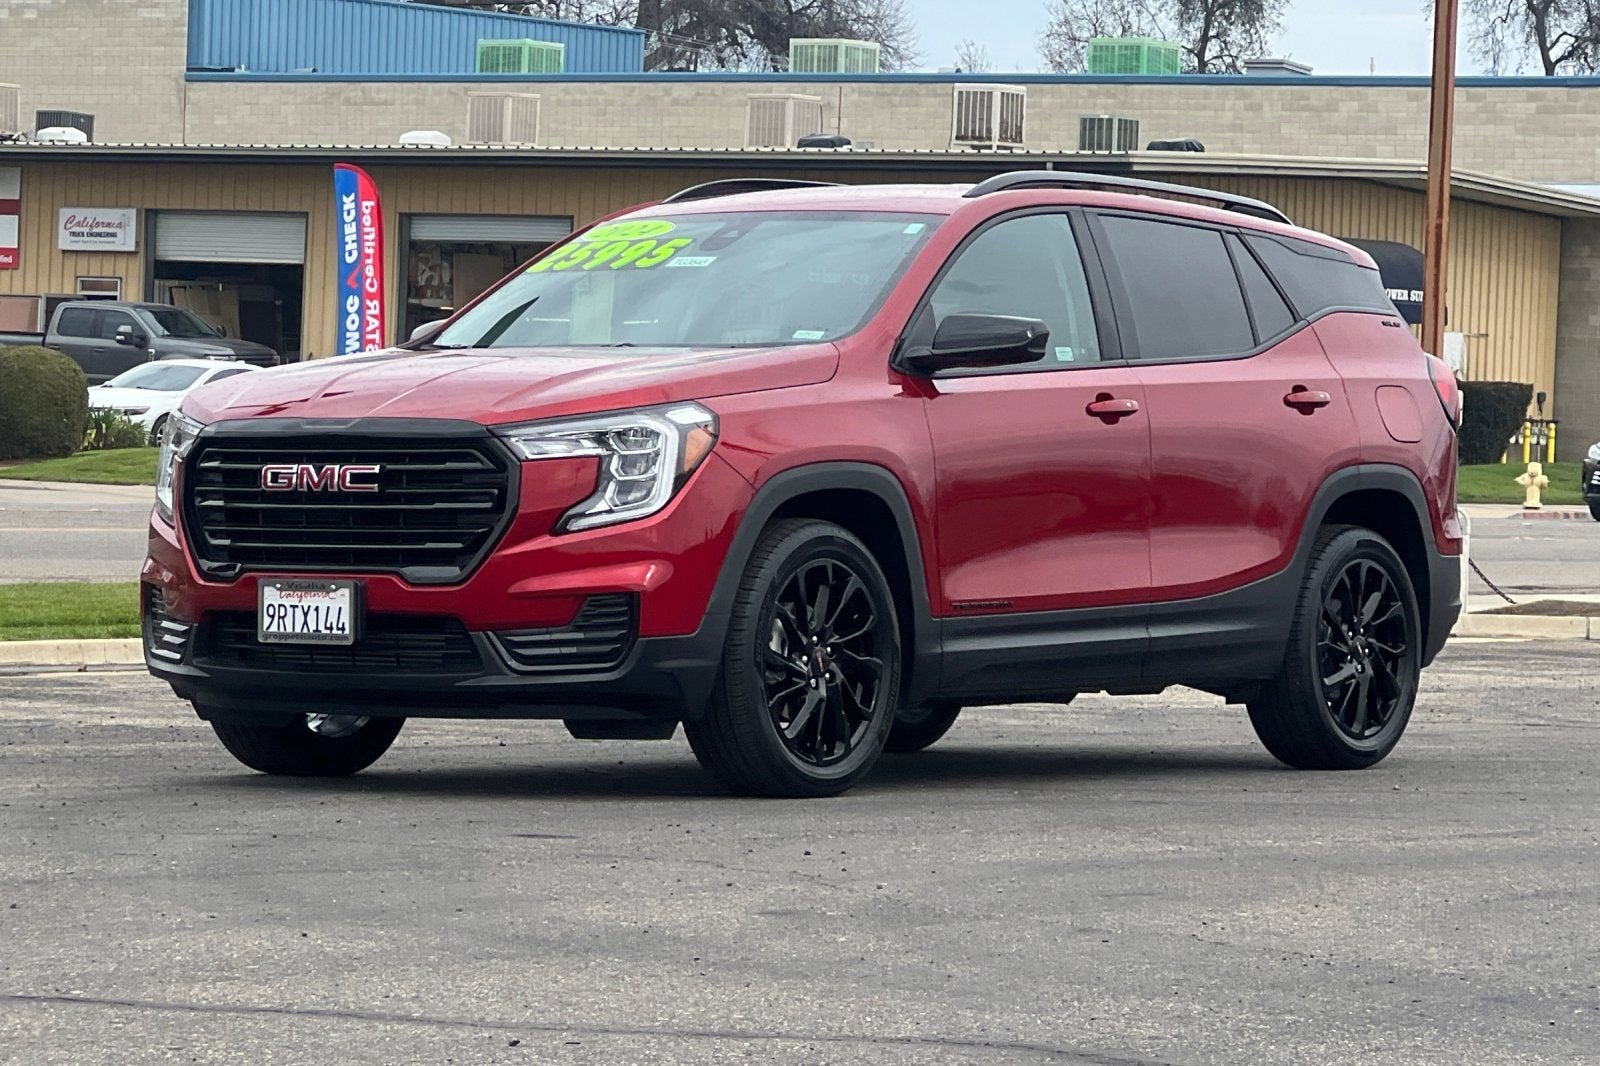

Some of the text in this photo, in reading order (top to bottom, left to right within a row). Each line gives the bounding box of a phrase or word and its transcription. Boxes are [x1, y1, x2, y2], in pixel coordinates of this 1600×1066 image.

[64, 214, 123, 231] California
[526, 238, 694, 274] 25995
[1385, 288, 1409, 301] OWER
[261, 464, 380, 492] GMC
[265, 603, 346, 635] 9RTX144
